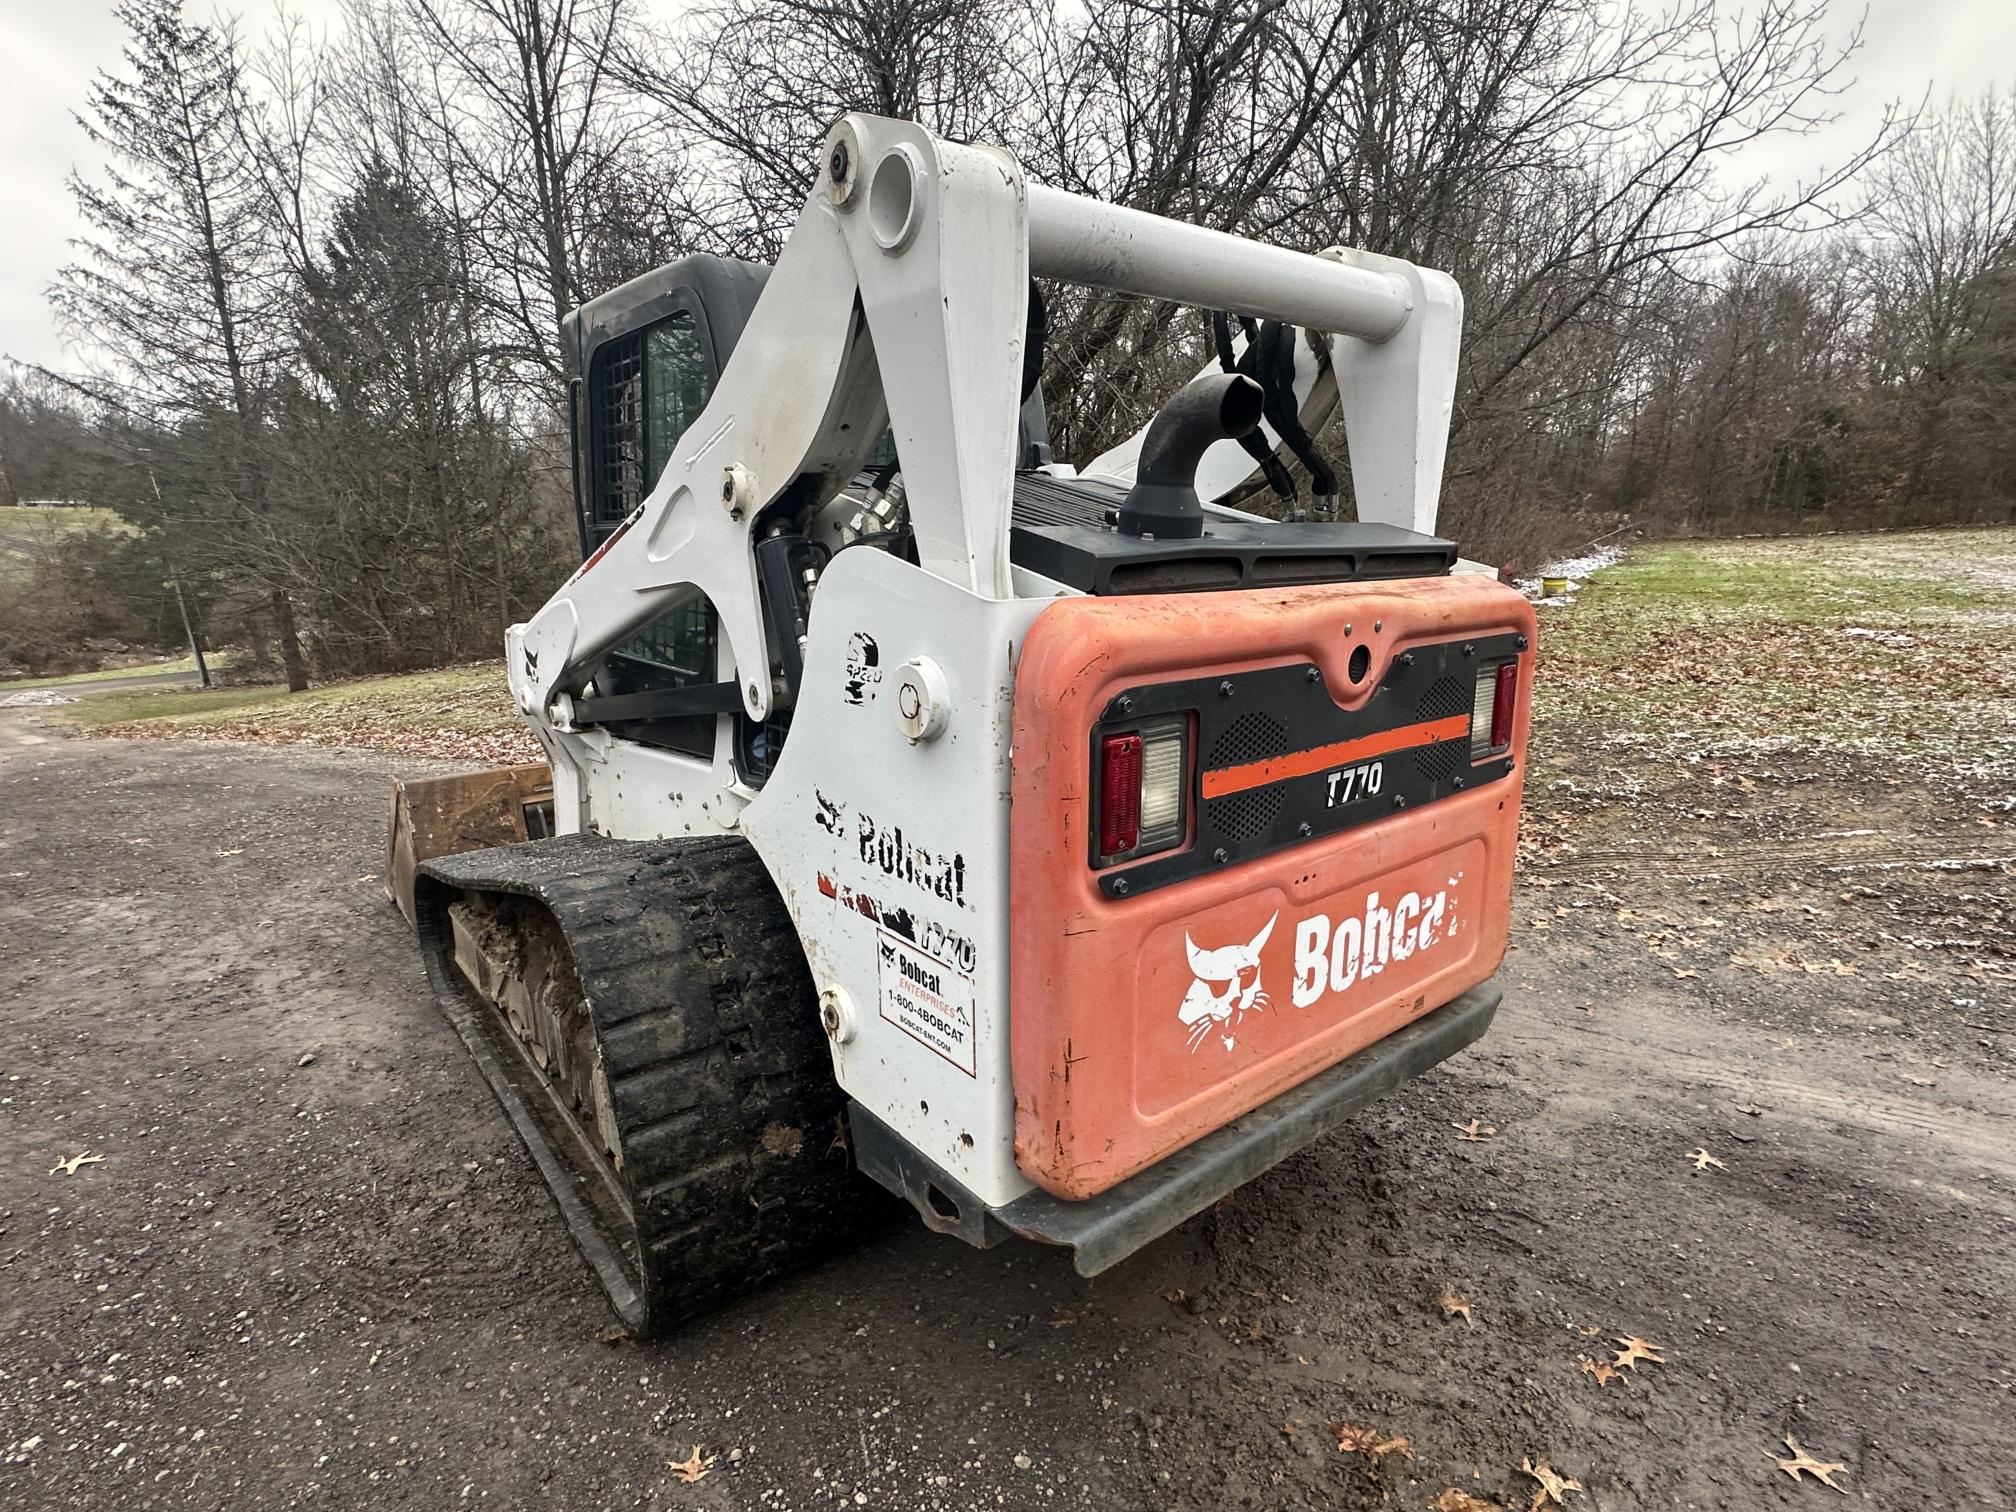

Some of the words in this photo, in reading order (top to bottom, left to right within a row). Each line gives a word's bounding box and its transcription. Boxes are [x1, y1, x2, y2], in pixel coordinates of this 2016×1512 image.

[1327, 762, 1383, 808] T770
[900, 953, 942, 996] Bobcat
[889, 989, 964, 1043] 1-800-4BOBCAT
[900, 978, 956, 1018] ENTERPRISES
[900, 1014, 952, 1053] BOBCAT-ENT.COM
